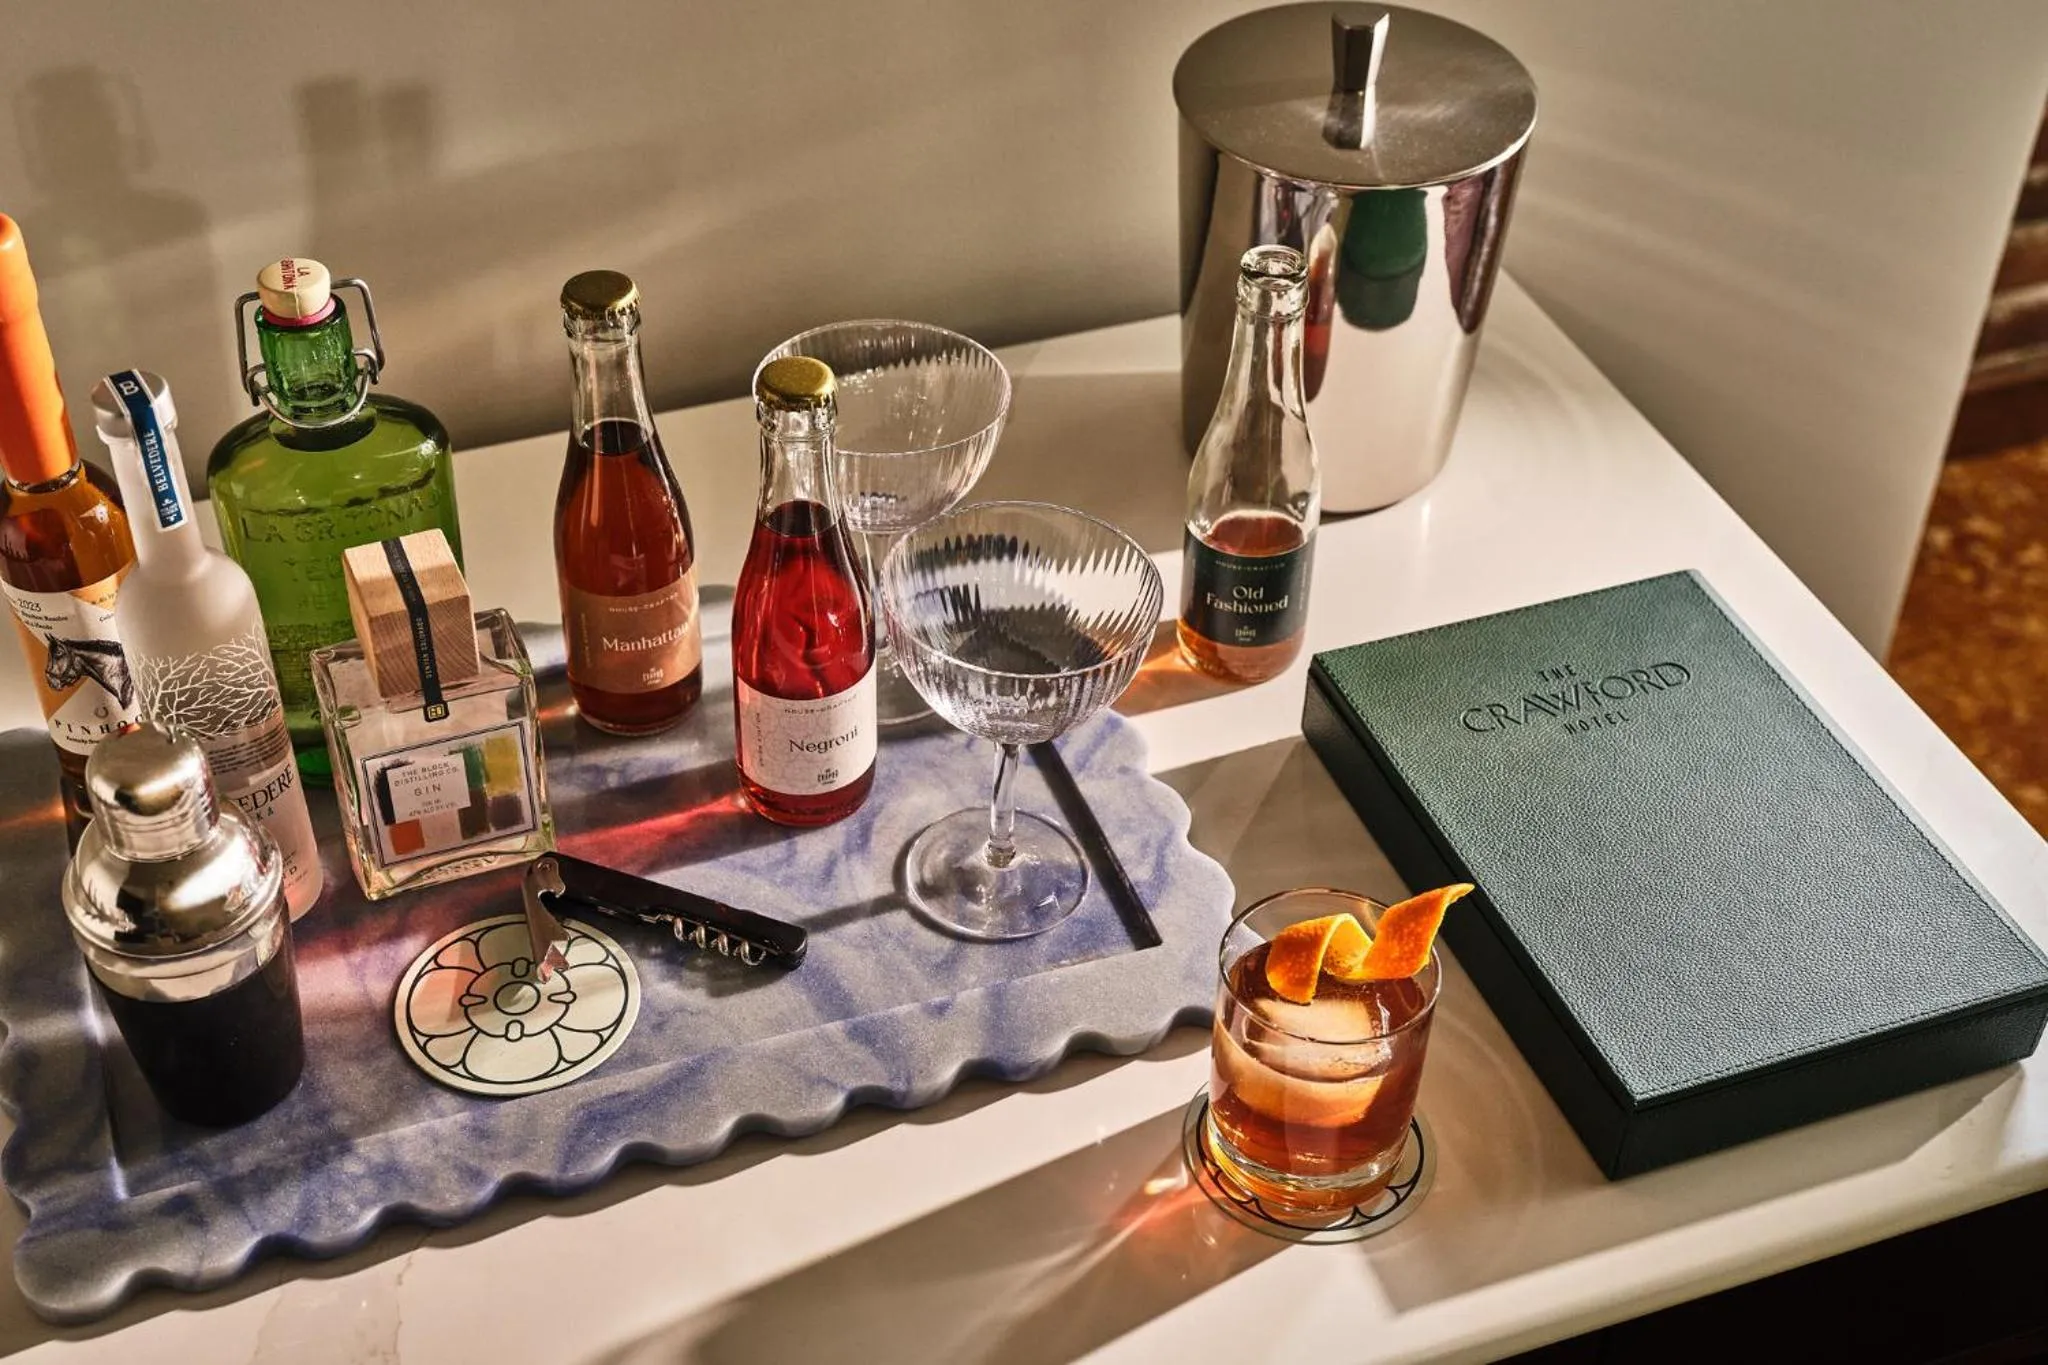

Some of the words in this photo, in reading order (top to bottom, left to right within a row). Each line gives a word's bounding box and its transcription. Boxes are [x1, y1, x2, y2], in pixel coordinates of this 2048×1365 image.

[119, 380, 140, 396] B
[144, 428, 169, 492] BELVEDERE
[1206, 592, 1289, 614] Fashioned
[1232, 585, 1264, 600] Old
[602, 621, 688, 652] Manhattan
[1538, 664, 1577, 682] THE
[1460, 662, 1691, 732] CRAWFORD
[1563, 711, 1630, 735] HOTEL
[789, 725, 858, 754] Negroni
[237, 763, 294, 813] EDERE
[414, 783, 442, 797] GIN
